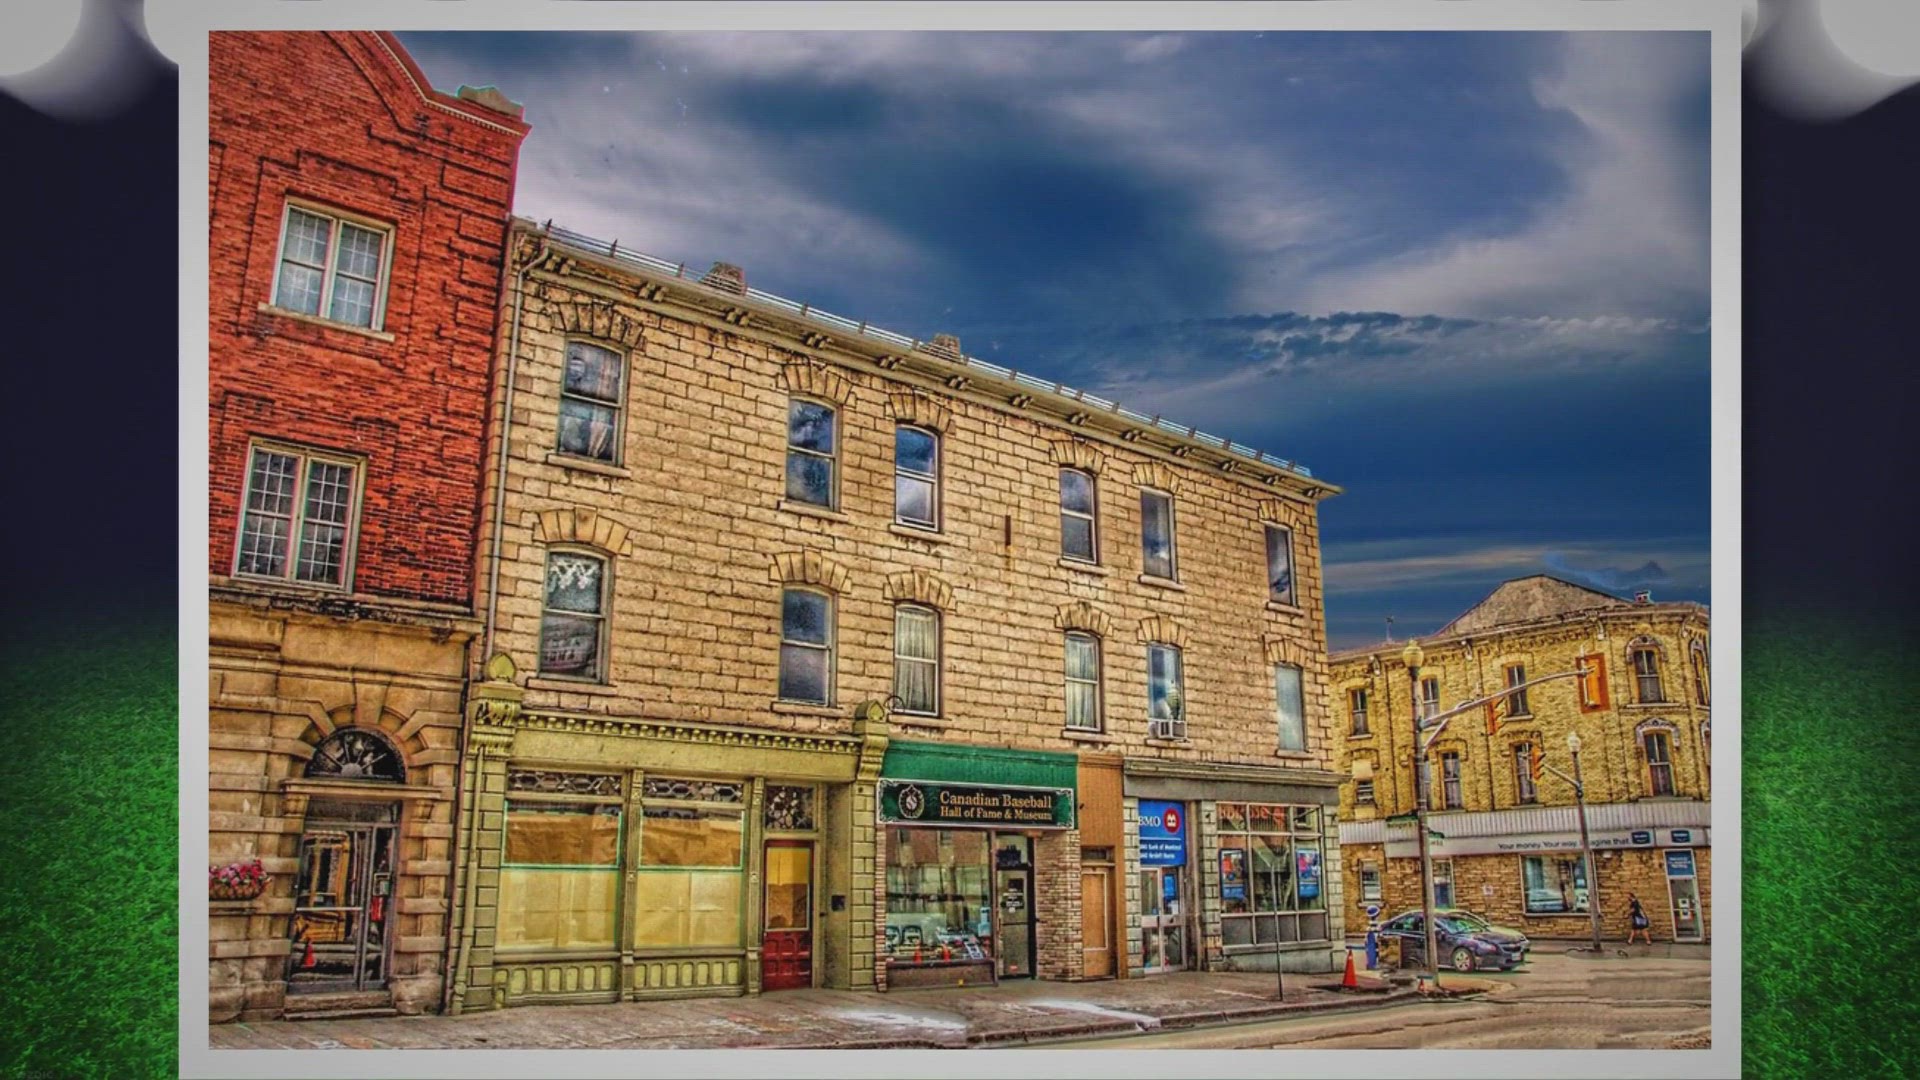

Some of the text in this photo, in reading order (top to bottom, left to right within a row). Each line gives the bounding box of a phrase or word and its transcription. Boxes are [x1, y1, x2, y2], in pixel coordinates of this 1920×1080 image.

[940, 790, 1051, 809] Canadian Baseball
[940, 806, 1053, 821] Hall of Fame & Museum
[1138, 815, 1161, 828] BMO
[1497, 842, 1515, 850] Your
[1542, 840, 1560, 848] Your
